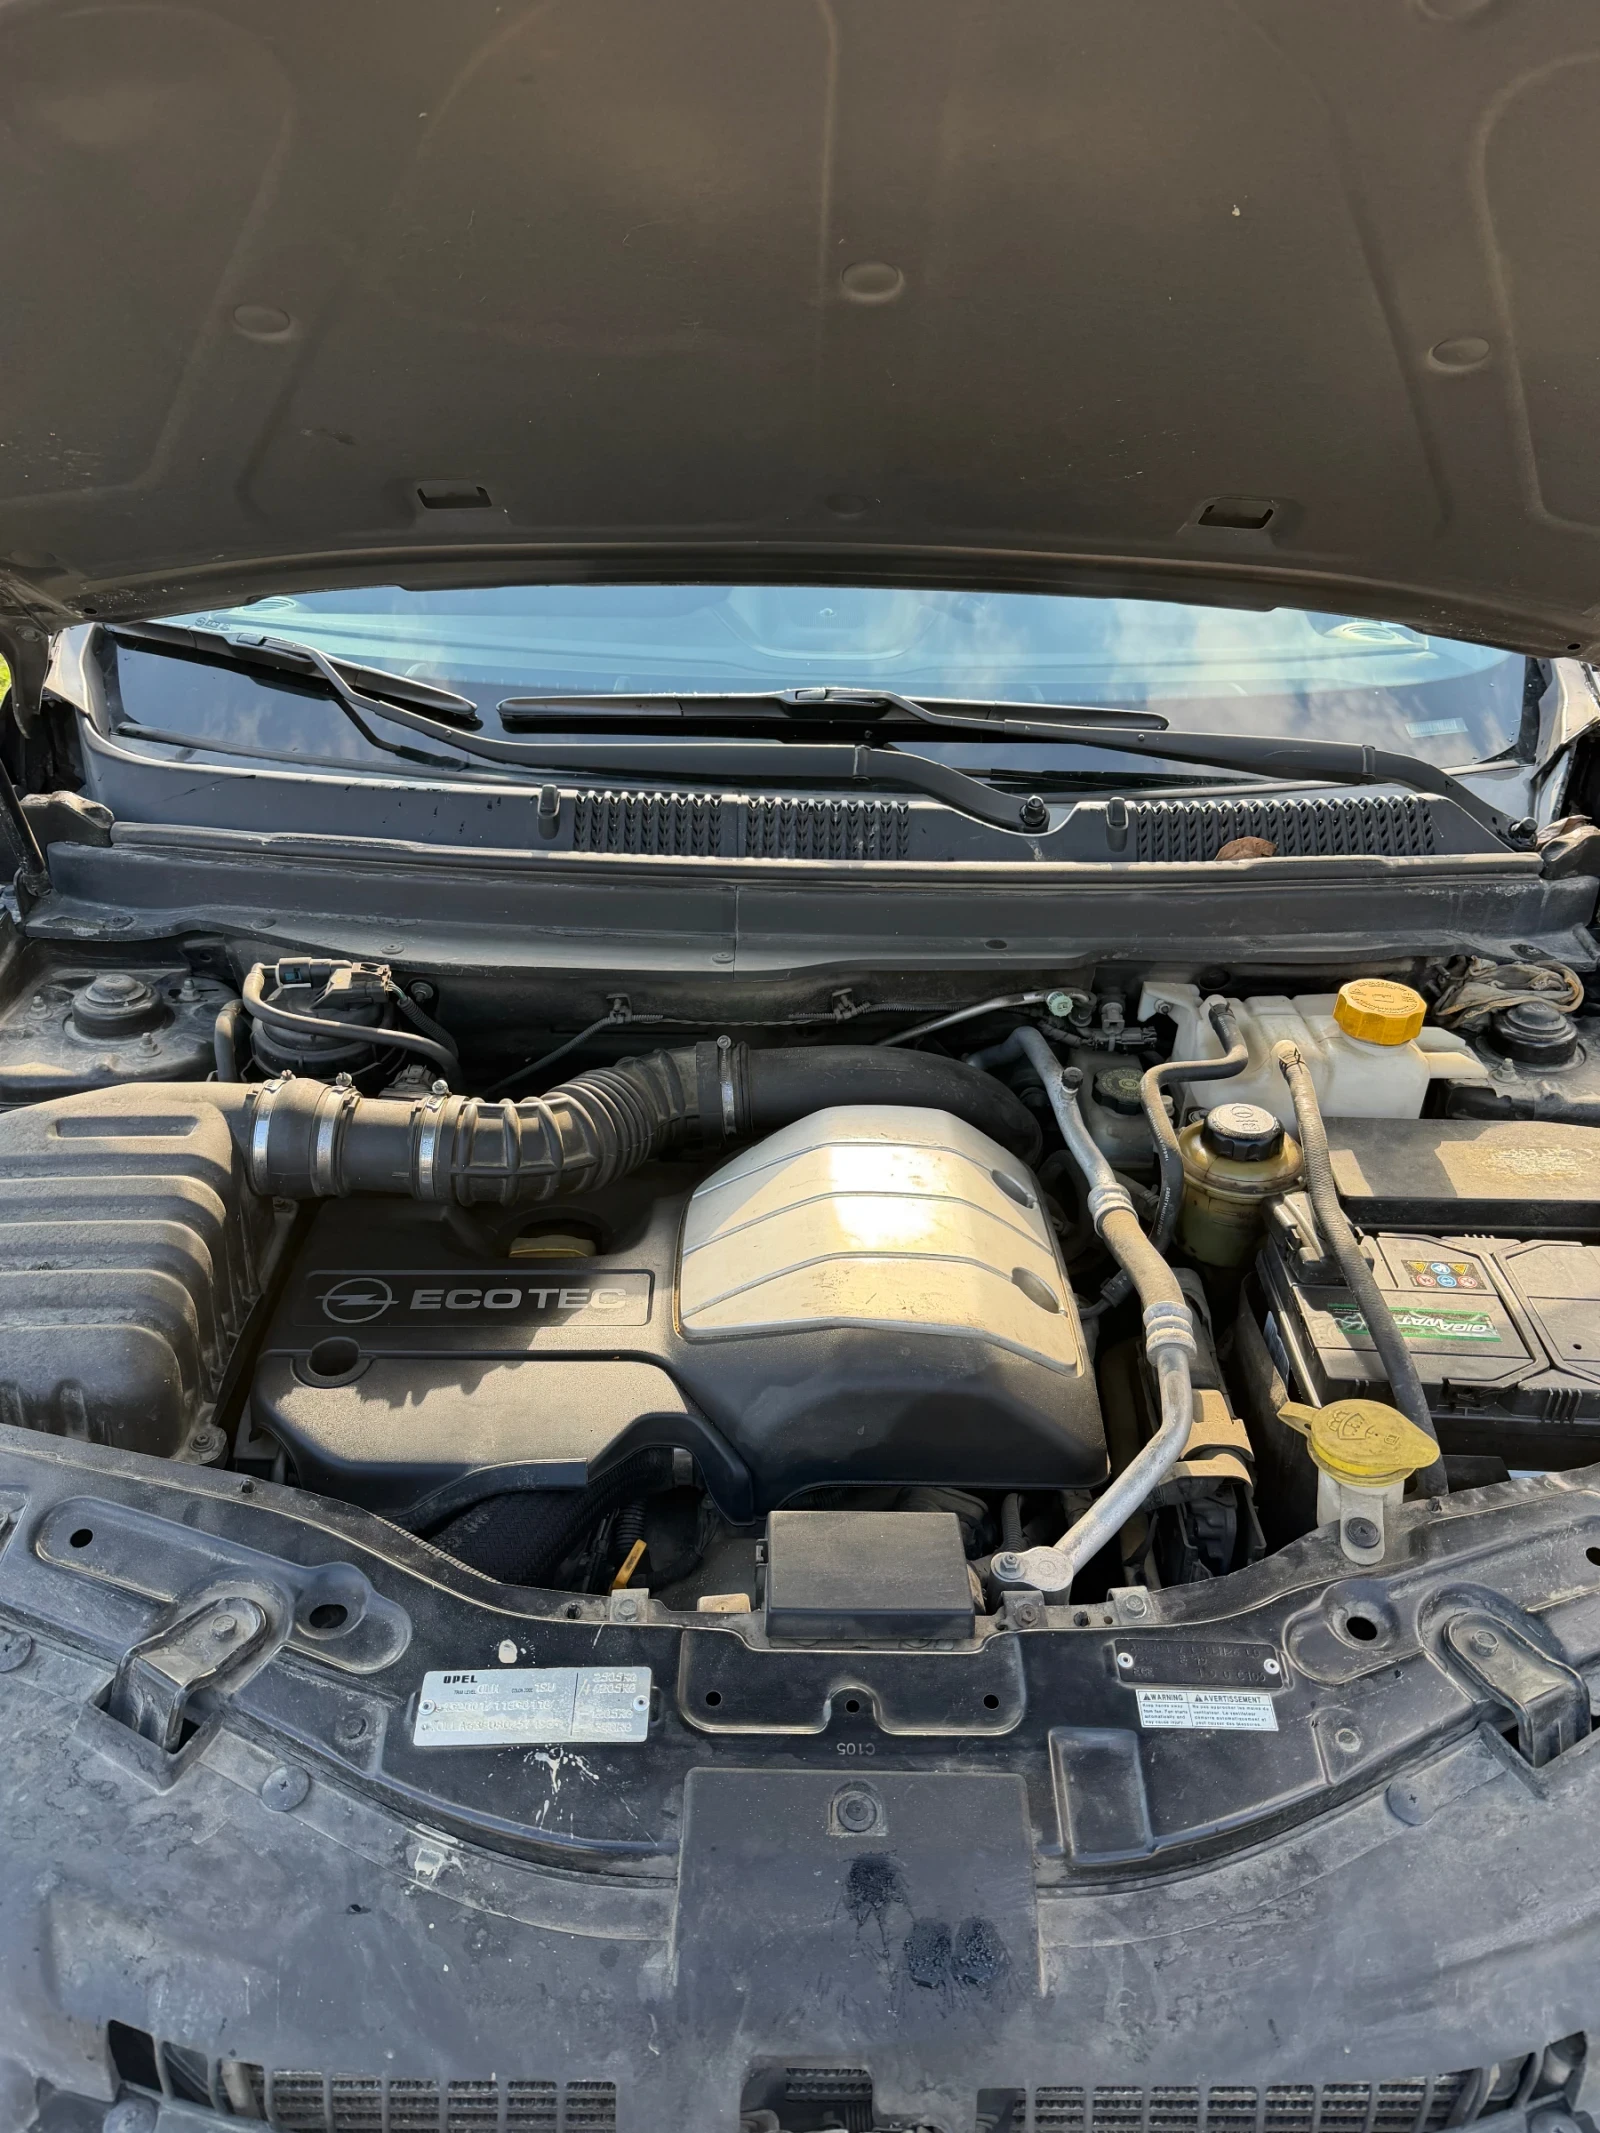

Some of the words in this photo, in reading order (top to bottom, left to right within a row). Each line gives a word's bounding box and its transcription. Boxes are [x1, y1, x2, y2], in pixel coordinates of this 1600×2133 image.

[409, 1287, 627, 1310] ECOTEC
[1395, 1315, 1487, 1333] GIGAWAT
[443, 1674, 478, 1684] OPEL
[1150, 1693, 1184, 1701] WARNING
[1203, 1694, 1262, 1704] AVERTISSEMENT
[837, 1742, 875, 1756] C105
